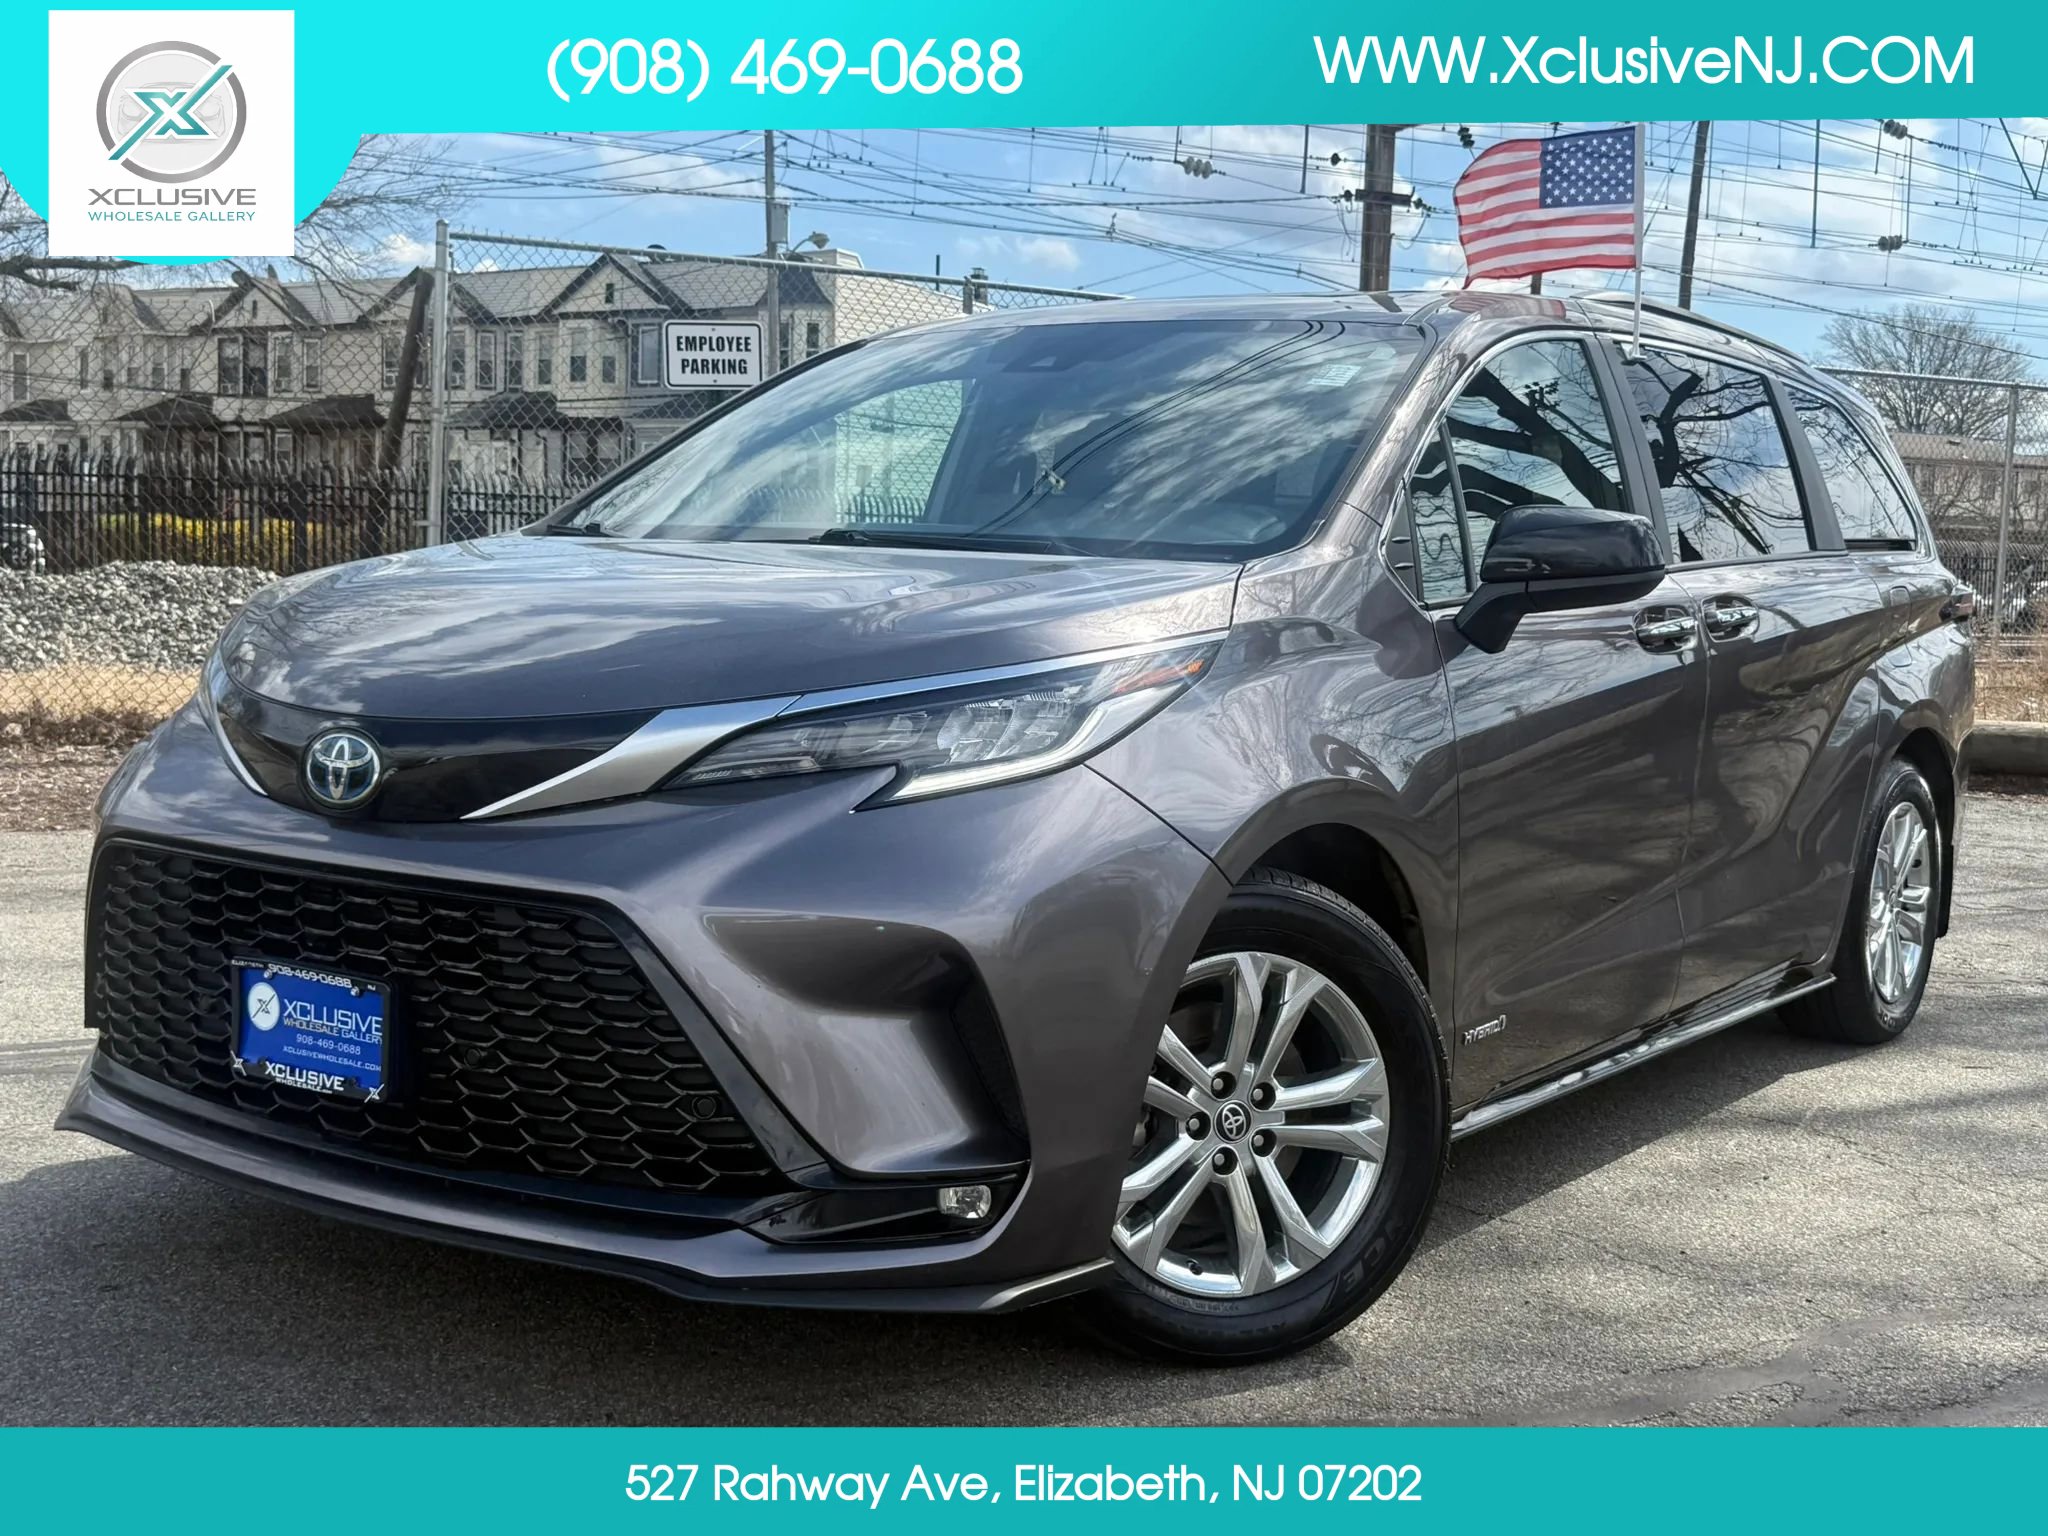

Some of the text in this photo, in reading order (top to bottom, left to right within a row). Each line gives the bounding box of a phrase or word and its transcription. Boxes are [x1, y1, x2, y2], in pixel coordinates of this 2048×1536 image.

[676, 335, 752, 352] EMPLOYEE
[681, 358, 748, 375] PARKING
[268, 963, 352, 988] 908-469-0688
[283, 999, 383, 1036] XCLUSIVE
[283, 1017, 340, 1036] WHOLESALE
[296, 1033, 361, 1055] 908-469-0688
[265, 1061, 345, 1091] XCLUSIVE
